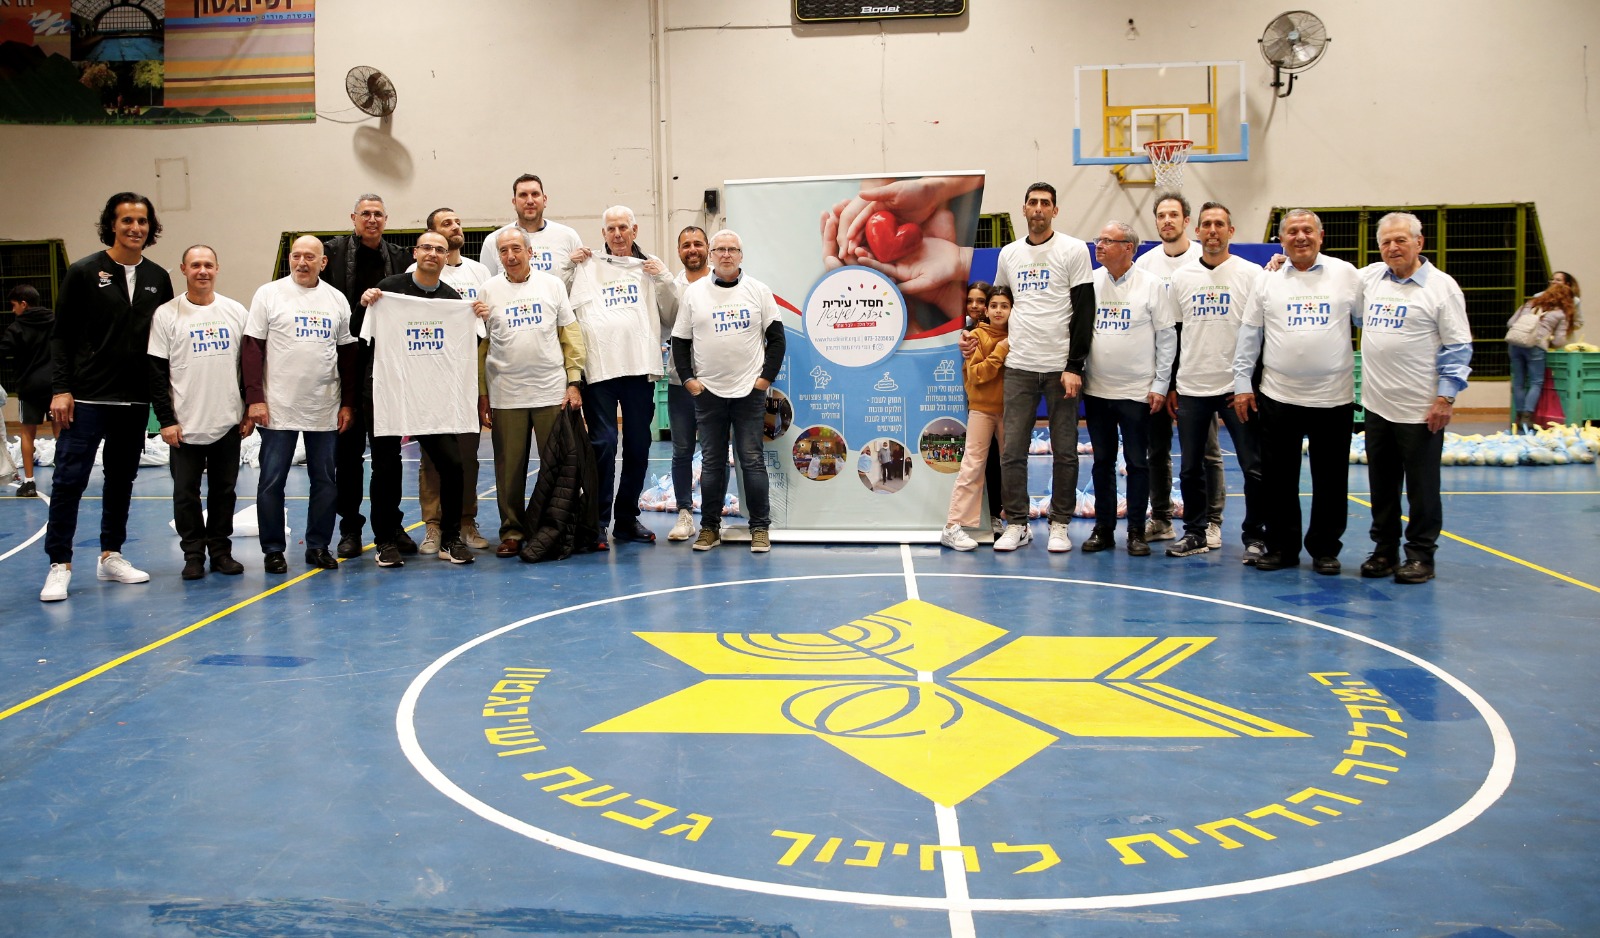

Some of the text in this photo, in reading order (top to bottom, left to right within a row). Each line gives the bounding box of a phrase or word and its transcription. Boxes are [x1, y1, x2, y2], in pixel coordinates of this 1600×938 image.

[860, 5, 901, 14] Bodet
[1018, 282, 1048, 292] עירית!
[605, 296, 638, 307] עירית!
[822, 299, 884, 309] חסדי עירית
[1193, 306, 1229, 316] עירית!
[715, 320, 750, 332] עירית!
[1096, 319, 1130, 330] עירית!
[1288, 316, 1329, 326] עירית!
[1367, 316, 1404, 328] עירית!
[296, 328, 331, 338] עירית!
[193, 340, 230, 352] עירית!
[408, 340, 443, 350] עירית!
[1308, 671, 1409, 785] המכללה
[521, 766, 713, 842] גבעת
[1105, 787, 1363, 865] הדתית
[771, 829, 1062, 875] לחינוך
